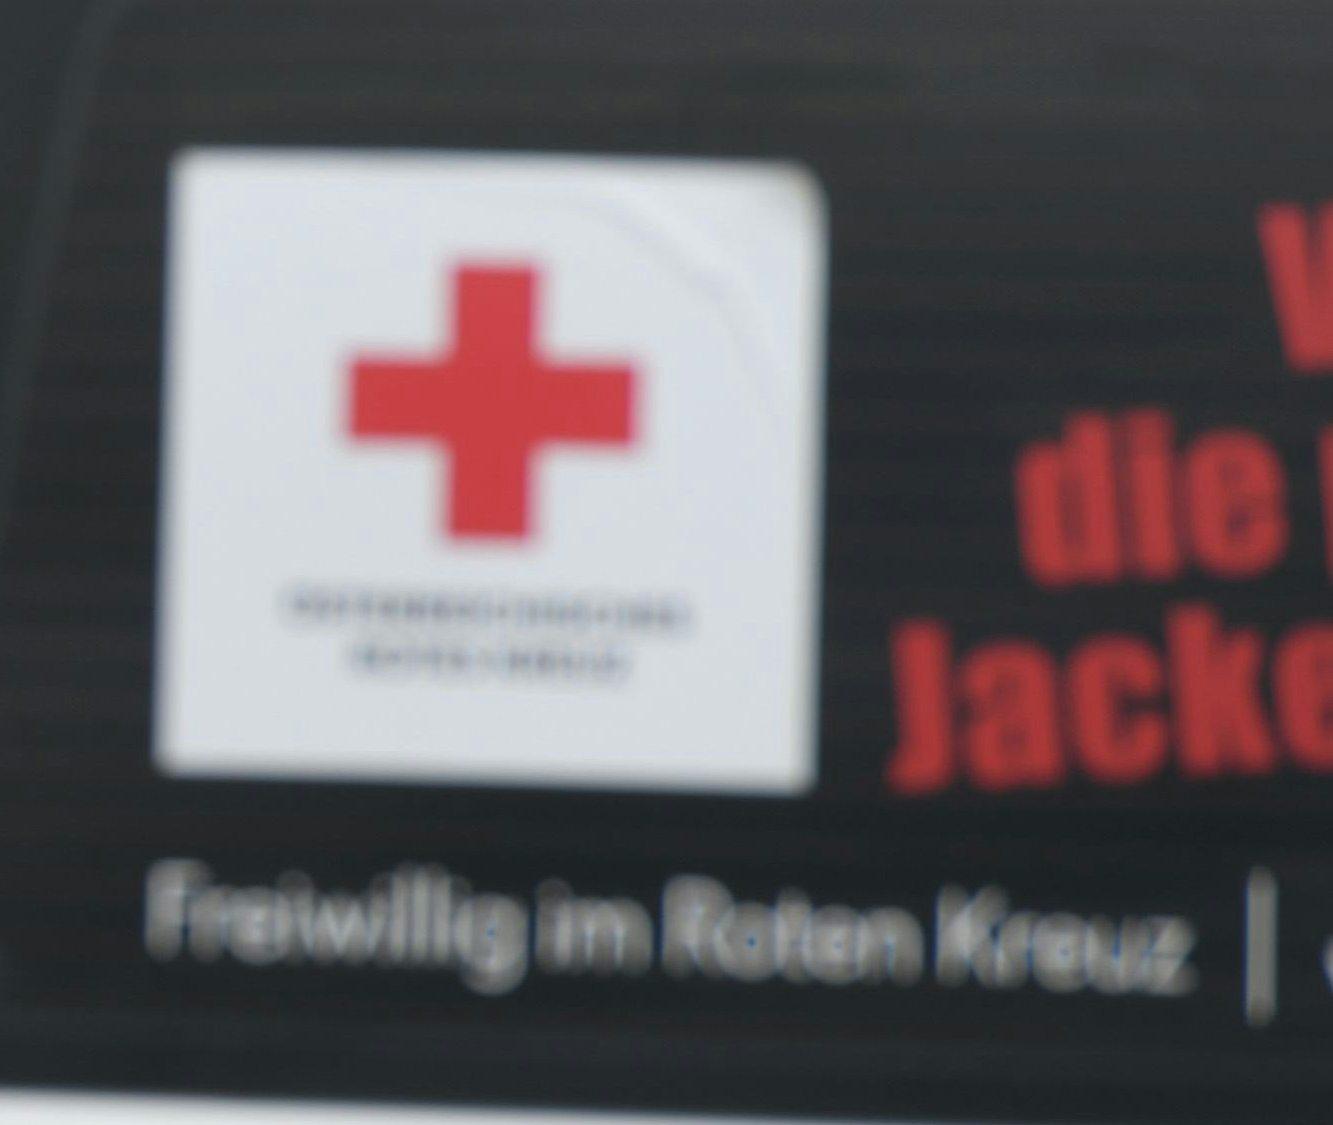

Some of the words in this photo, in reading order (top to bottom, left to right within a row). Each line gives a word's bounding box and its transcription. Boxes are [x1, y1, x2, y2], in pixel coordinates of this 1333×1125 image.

[1016, 410, 1290, 587] die
[145, 857, 530, 995] Freiwillig
[661, 874, 925, 988] Roten
[936, 883, 1199, 997] Kreuz
